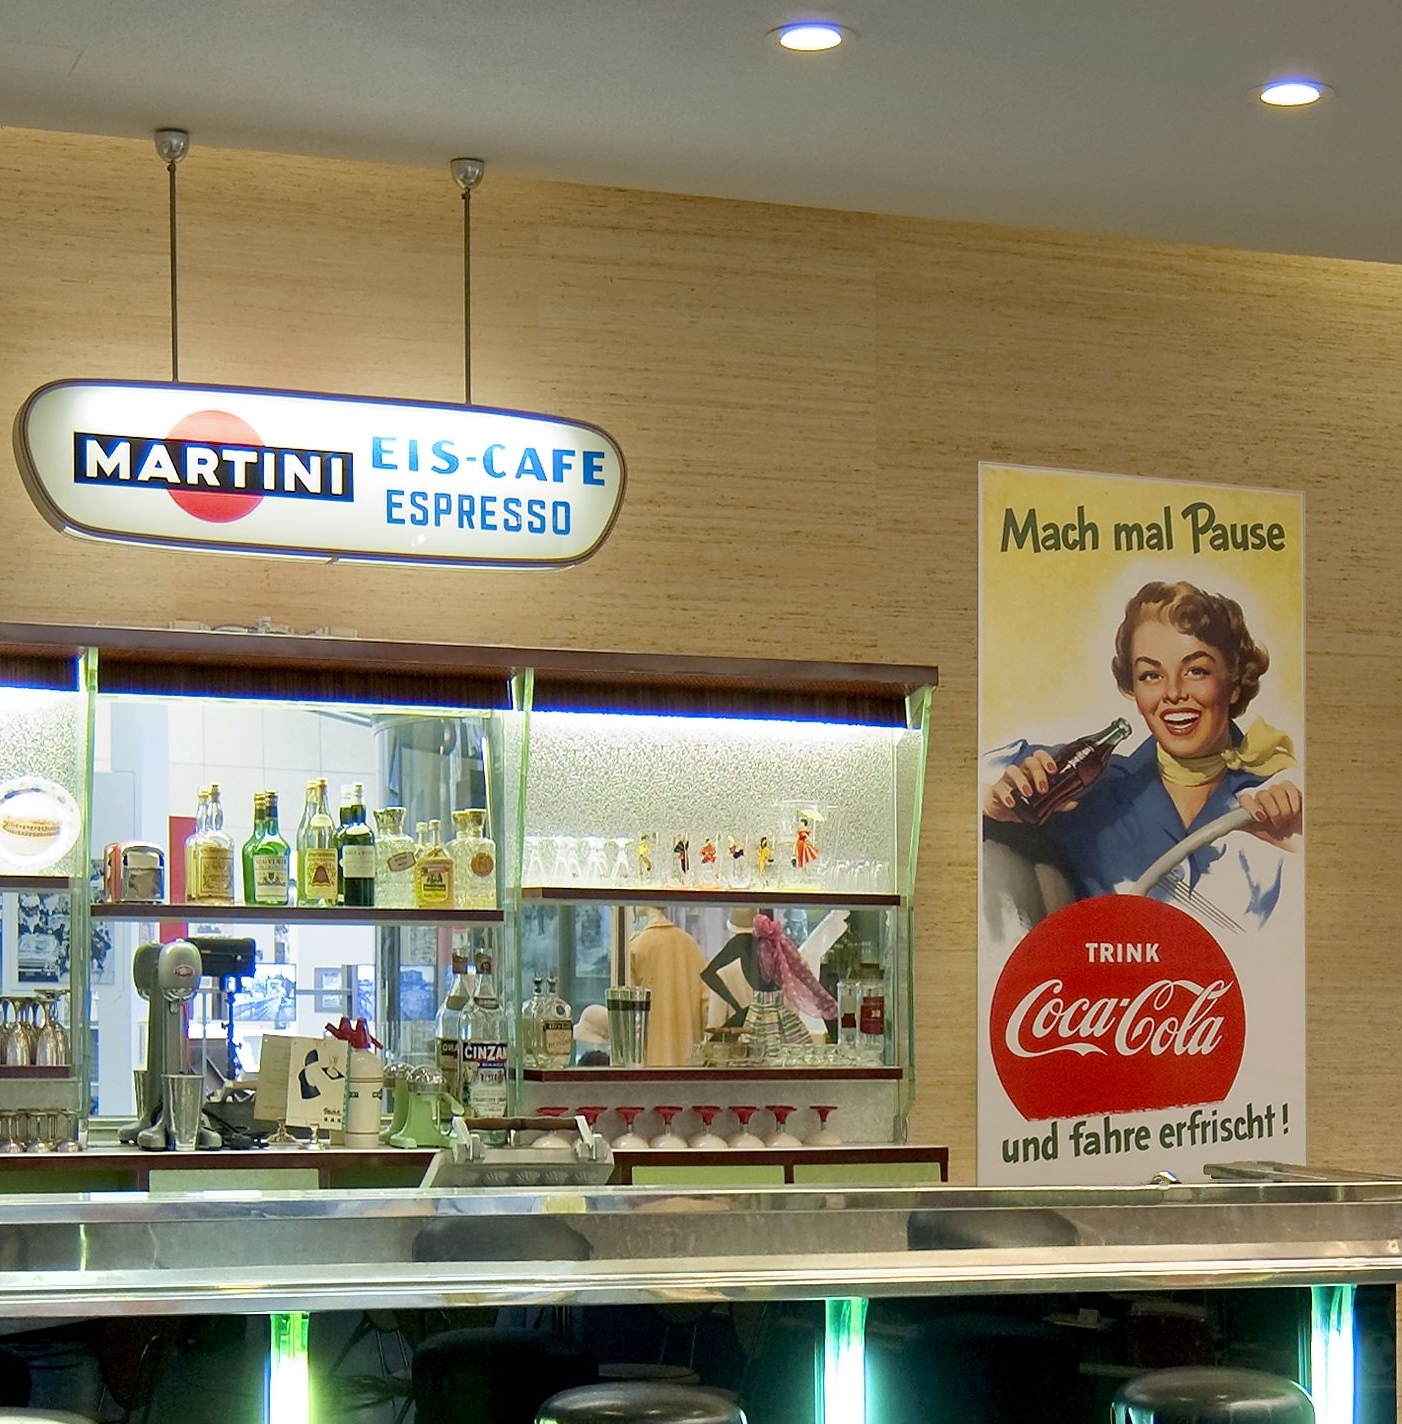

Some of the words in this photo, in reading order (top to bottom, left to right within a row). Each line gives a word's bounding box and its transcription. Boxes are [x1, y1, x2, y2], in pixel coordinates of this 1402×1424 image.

[83, 438, 345, 497] MARTINI
[371, 435, 606, 487] EIS-CAFE
[386, 489, 571, 535] ESPRESSO
[1000, 506, 1100, 554] Mach
[1114, 506, 1175, 553] mal
[1182, 502, 1286, 553] Pause
[1085, 943, 1159, 964] TRINK
[1005, 978, 1236, 1060] Coca-Cola
[1001, 1121, 1059, 1165] und
[1068, 1112, 1151, 1158] fahre
